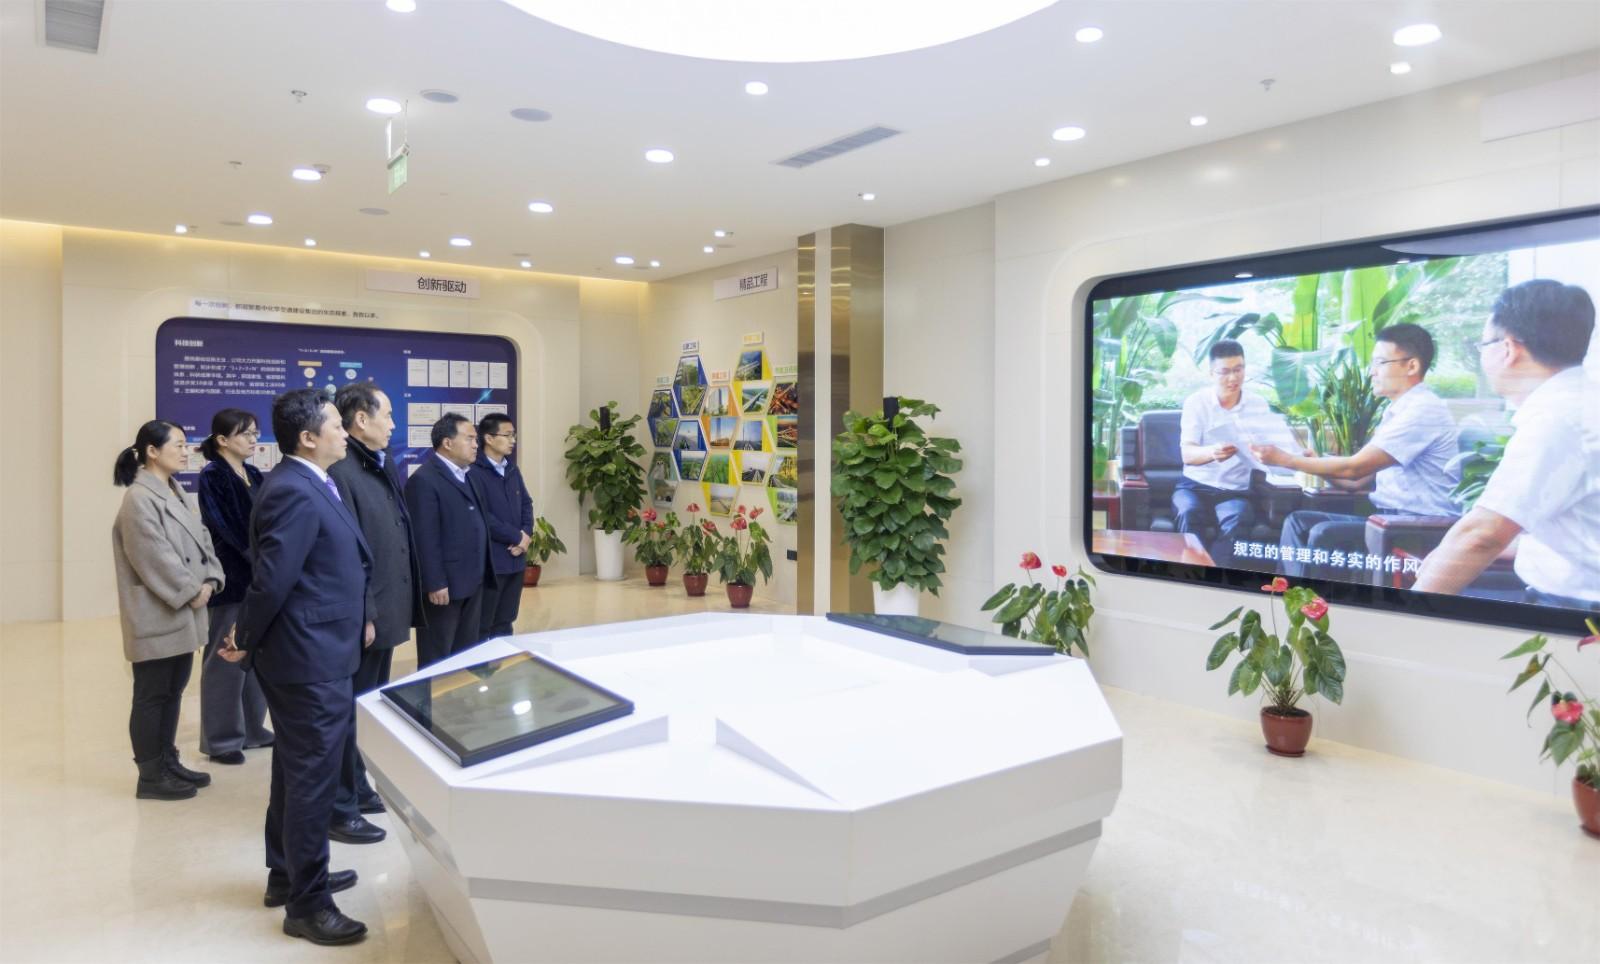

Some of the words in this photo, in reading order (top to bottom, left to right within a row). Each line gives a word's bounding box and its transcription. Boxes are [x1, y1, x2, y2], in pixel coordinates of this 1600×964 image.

[417, 276, 467, 294] 创新驱动
[740, 273, 768, 291] 精品工程
[1233, 540, 1420, 574] 规范的管理和务实的作风
